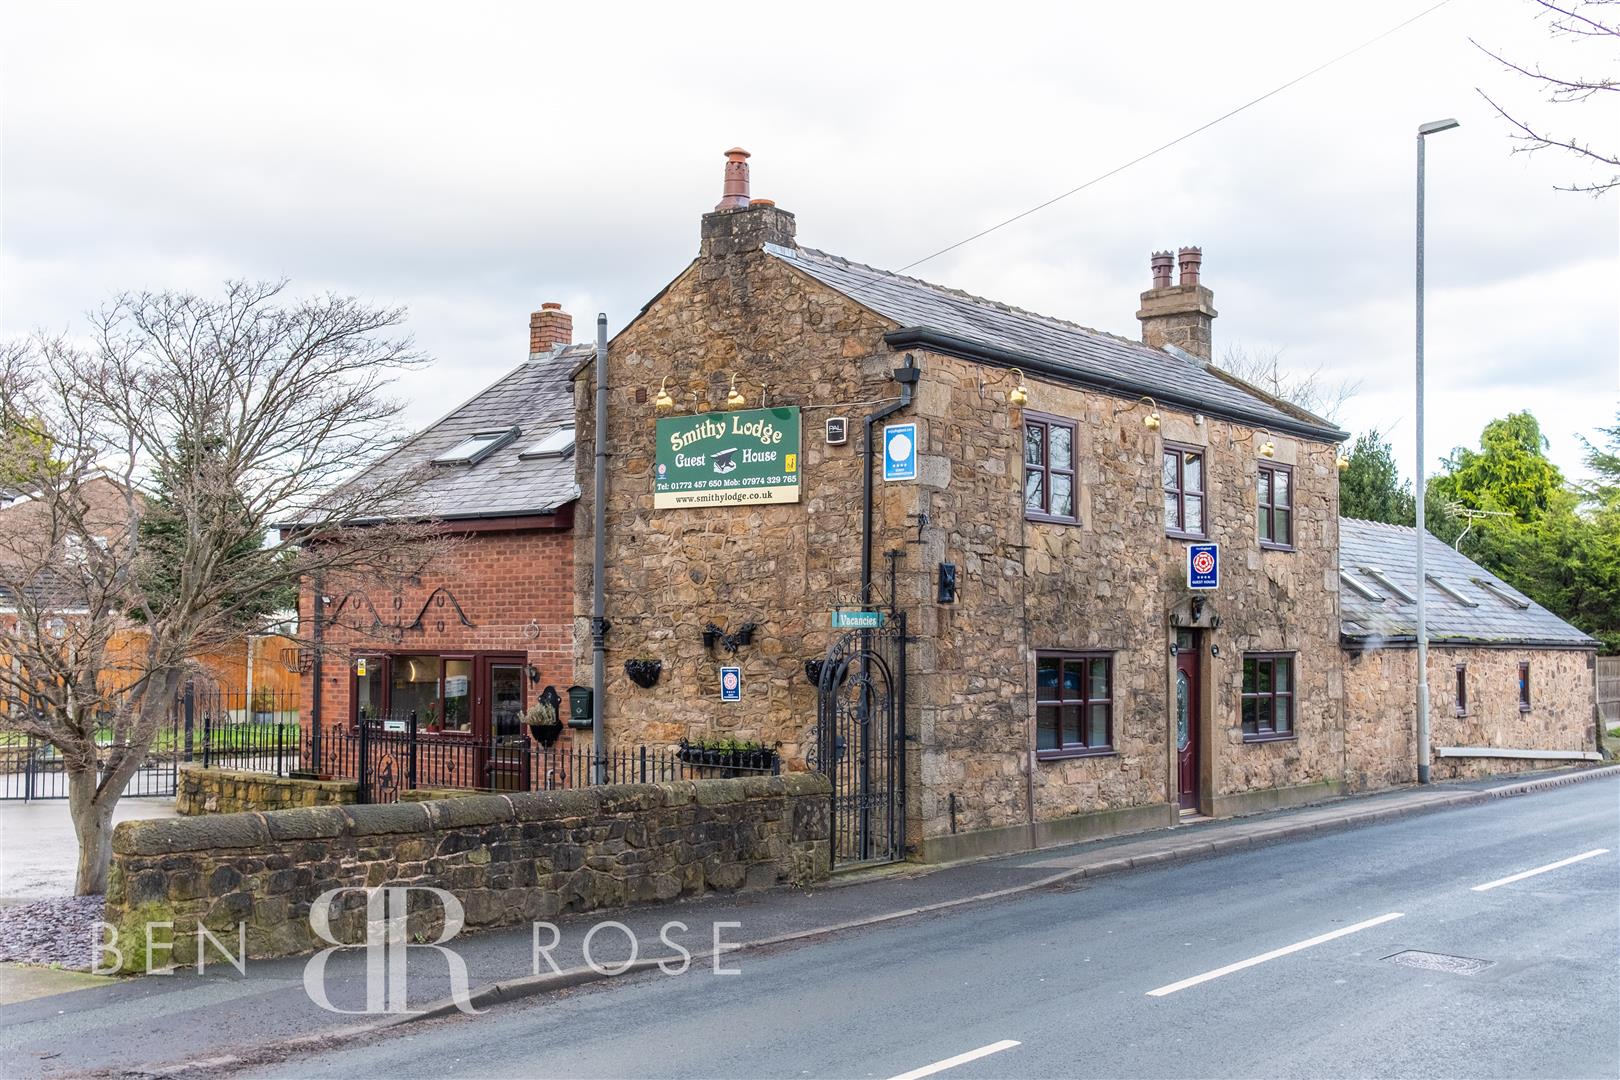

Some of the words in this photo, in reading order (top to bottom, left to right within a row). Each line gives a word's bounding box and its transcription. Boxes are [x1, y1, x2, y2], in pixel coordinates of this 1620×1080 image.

[670, 418, 726, 452] Smithy
[732, 416, 783, 445] Lodge
[675, 453, 706, 468] Guest
[742, 448, 777, 463] House
[671, 481, 692, 490] 01772
[723, 479, 741, 487] Mob:
[742, 477, 765, 486] 07974
[766, 475, 781, 484] 329
[782, 474, 797, 483] 765
[675, 491, 773, 504] www.smithylodge.co.uk
[839, 614, 877, 626] Vacancies
